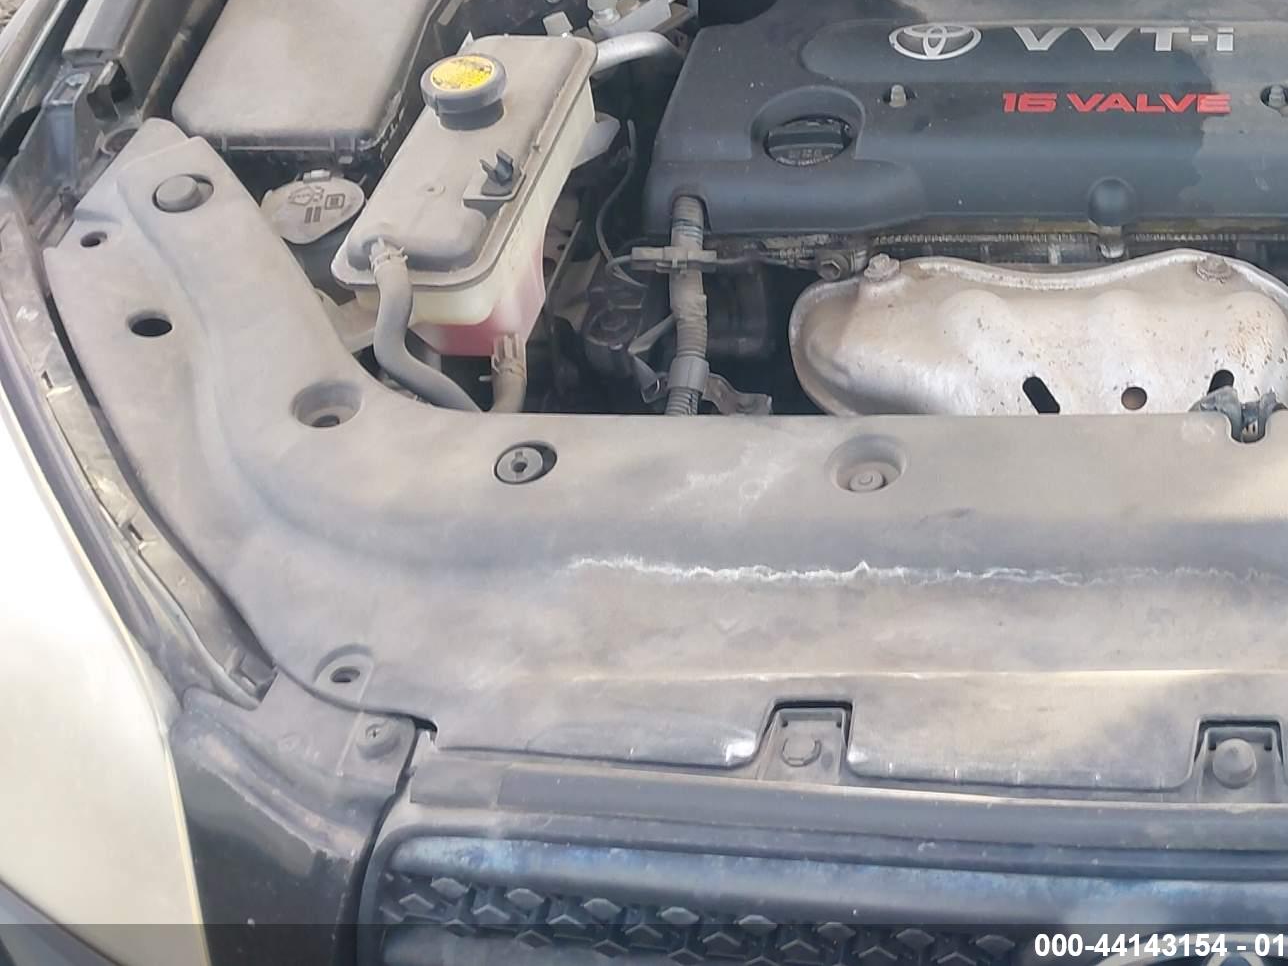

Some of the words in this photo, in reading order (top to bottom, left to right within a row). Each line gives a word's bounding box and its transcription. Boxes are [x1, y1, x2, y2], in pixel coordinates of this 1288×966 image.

[1012, 26, 1235, 52] VVT-i
[1002, 92, 1058, 113] 16
[1066, 92, 1232, 114] VALVE
